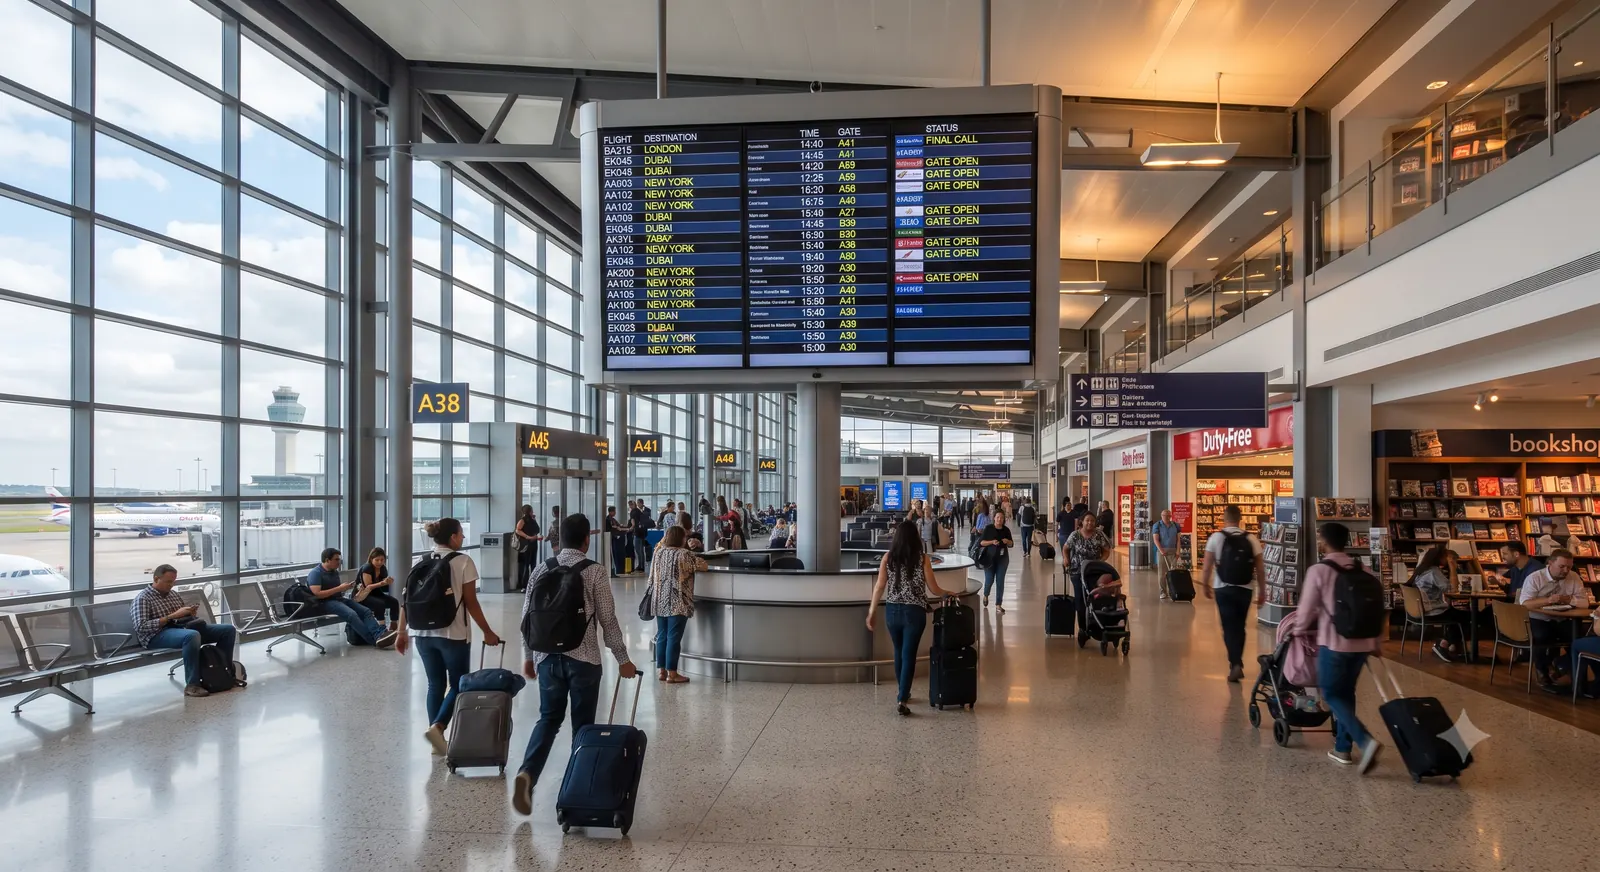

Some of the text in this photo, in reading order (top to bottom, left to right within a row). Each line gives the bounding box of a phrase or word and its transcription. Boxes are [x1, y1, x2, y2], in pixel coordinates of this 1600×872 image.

[926, 124, 958, 133] STATUS
[800, 129, 819, 137] TIME
[604, 134, 697, 144] FLIGHT DESTINATION
[926, 136, 952, 144] FINAL
[954, 135, 978, 143] CALL
[800, 139, 854, 148] 14:40 A41
[605, 145, 682, 155] BA215 LONDON
[801, 151, 823, 159] 14:45
[605, 156, 671, 165] EK045 DUBAI
[801, 162, 823, 170] 14:20
[645, 167, 671, 175] DUBAI
[926, 170, 950, 178] GATE
[801, 174, 823, 182] 12:25
[645, 179, 666, 187] NEW
[668, 178, 693, 186] YORK
[926, 182, 950, 190] GATE
[953, 181, 979, 189] OPEN
[605, 189, 693, 199] AA102 NEW YORK
[801, 197, 823, 206] 16:75
[605, 203, 632, 211] AA102
[926, 206, 950, 214] GATE
[646, 213, 672, 221] DUBAI
[801, 209, 823, 217] 15:40
[840, 219, 856, 227] B39
[926, 218, 950, 226] GATE
[926, 238, 950, 246] GATE
[606, 246, 633, 254] AA102
[648, 324, 674, 332] DUBAI
[802, 332, 825, 340] 15:50
[418, 394, 460, 413] A38
[529, 431, 549, 450] A45
[1203, 428, 1252, 455] Duty-Free
[634, 440, 657, 452] A41
[716, 454, 734, 463] A48
